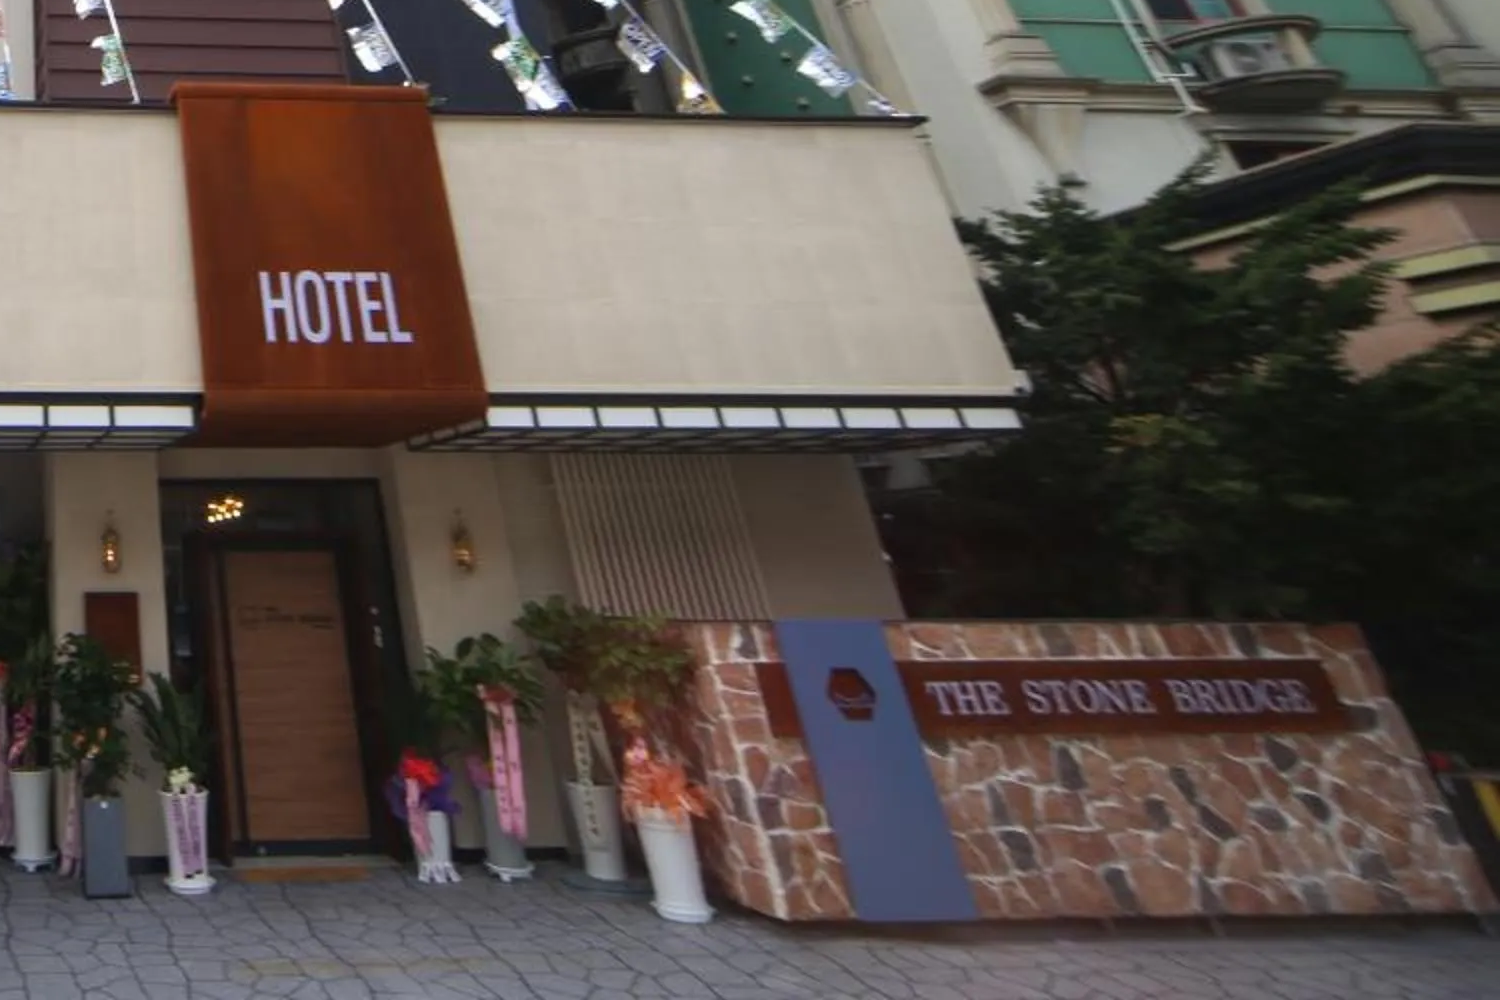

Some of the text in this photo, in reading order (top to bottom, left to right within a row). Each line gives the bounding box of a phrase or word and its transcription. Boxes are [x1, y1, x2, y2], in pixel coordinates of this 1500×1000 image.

[258, 269, 414, 344] HOTEL
[925, 678, 1318, 716] THE STONE BRIDGE
